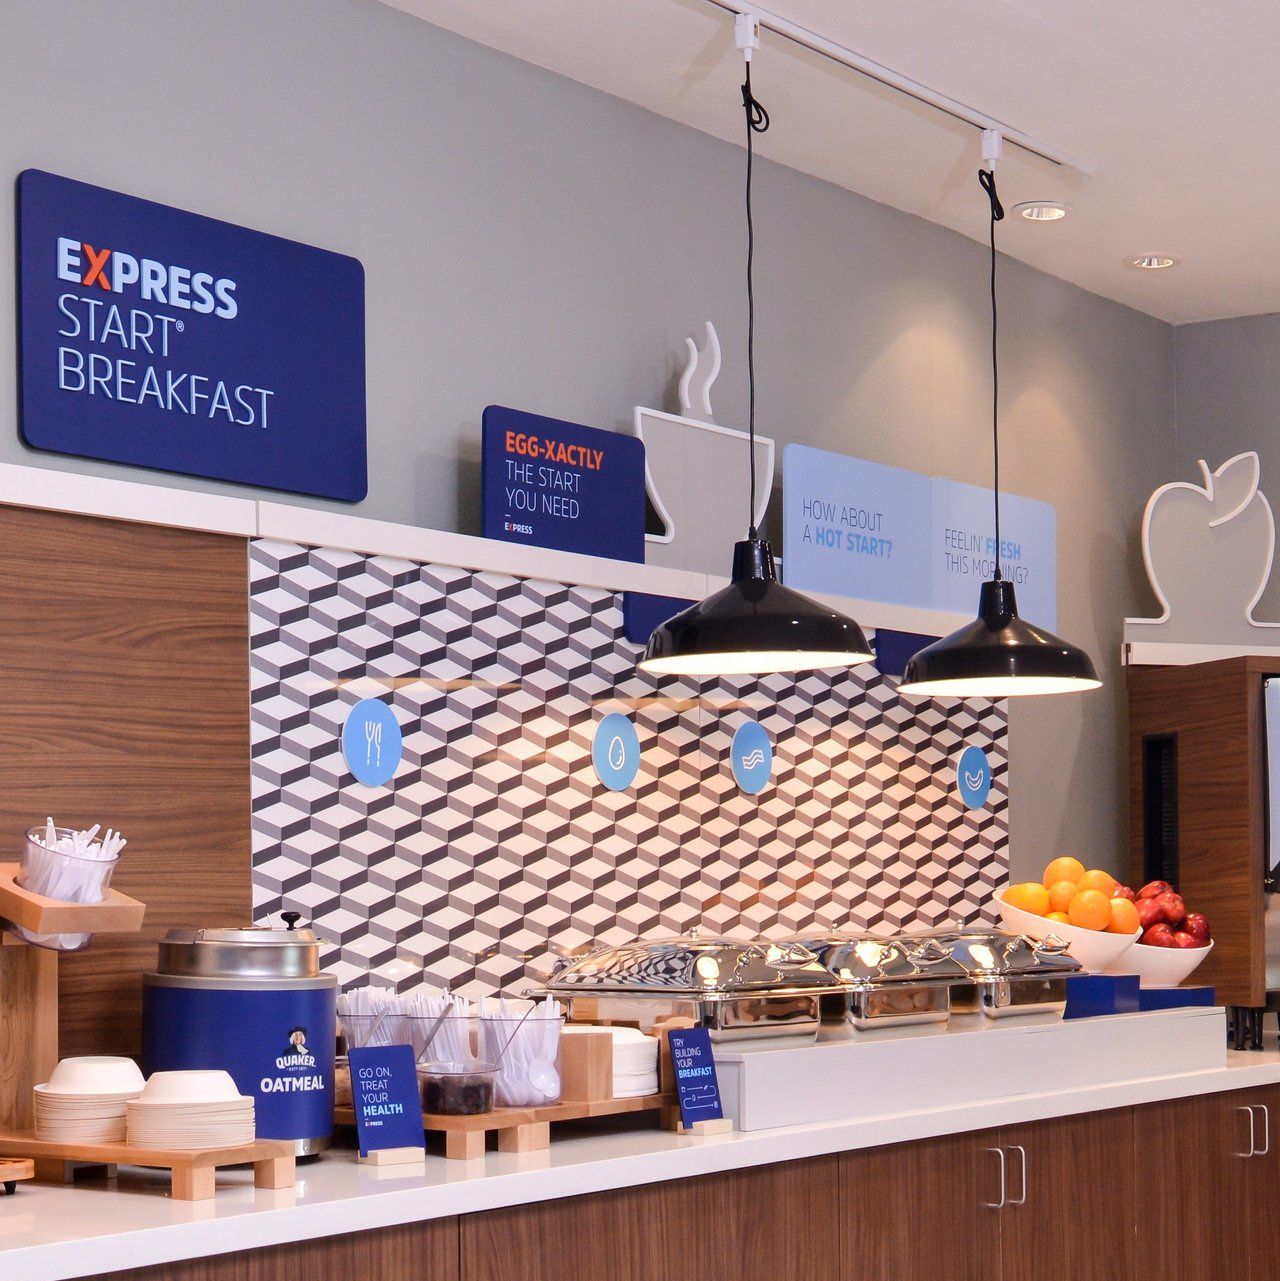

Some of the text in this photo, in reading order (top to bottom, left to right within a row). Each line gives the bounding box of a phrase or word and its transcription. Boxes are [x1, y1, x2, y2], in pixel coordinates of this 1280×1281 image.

[57, 236, 238, 320] EXPRESS
[58, 346, 274, 429] BREAKFAST
[505, 431, 604, 470] EGG-XACTLY
[505, 460, 581, 493] THE START
[505, 487, 580, 519] YOU NEED
[802, 497, 883, 532] HOW ABOUT
[504, 521, 533, 535] EXPRESS
[802, 524, 892, 558] A HOT START?
[944, 528, 984, 553] FEELIN'
[944, 552, 969, 575] THIS
[673, 1038, 684, 1048] TRY
[674, 1047, 701, 1058] BUILDING
[276, 1054, 315, 1069] QUAKER
[676, 1058, 693, 1068] YOUR
[359, 1067, 392, 1078] GO ON.
[678, 1066, 712, 1079] BREAKFAST
[260, 1075, 325, 1093] OATMEAL
[360, 1079, 388, 1091] TREAT
[361, 1092, 388, 1103] YOUR
[363, 1103, 403, 1117] HEALTH
